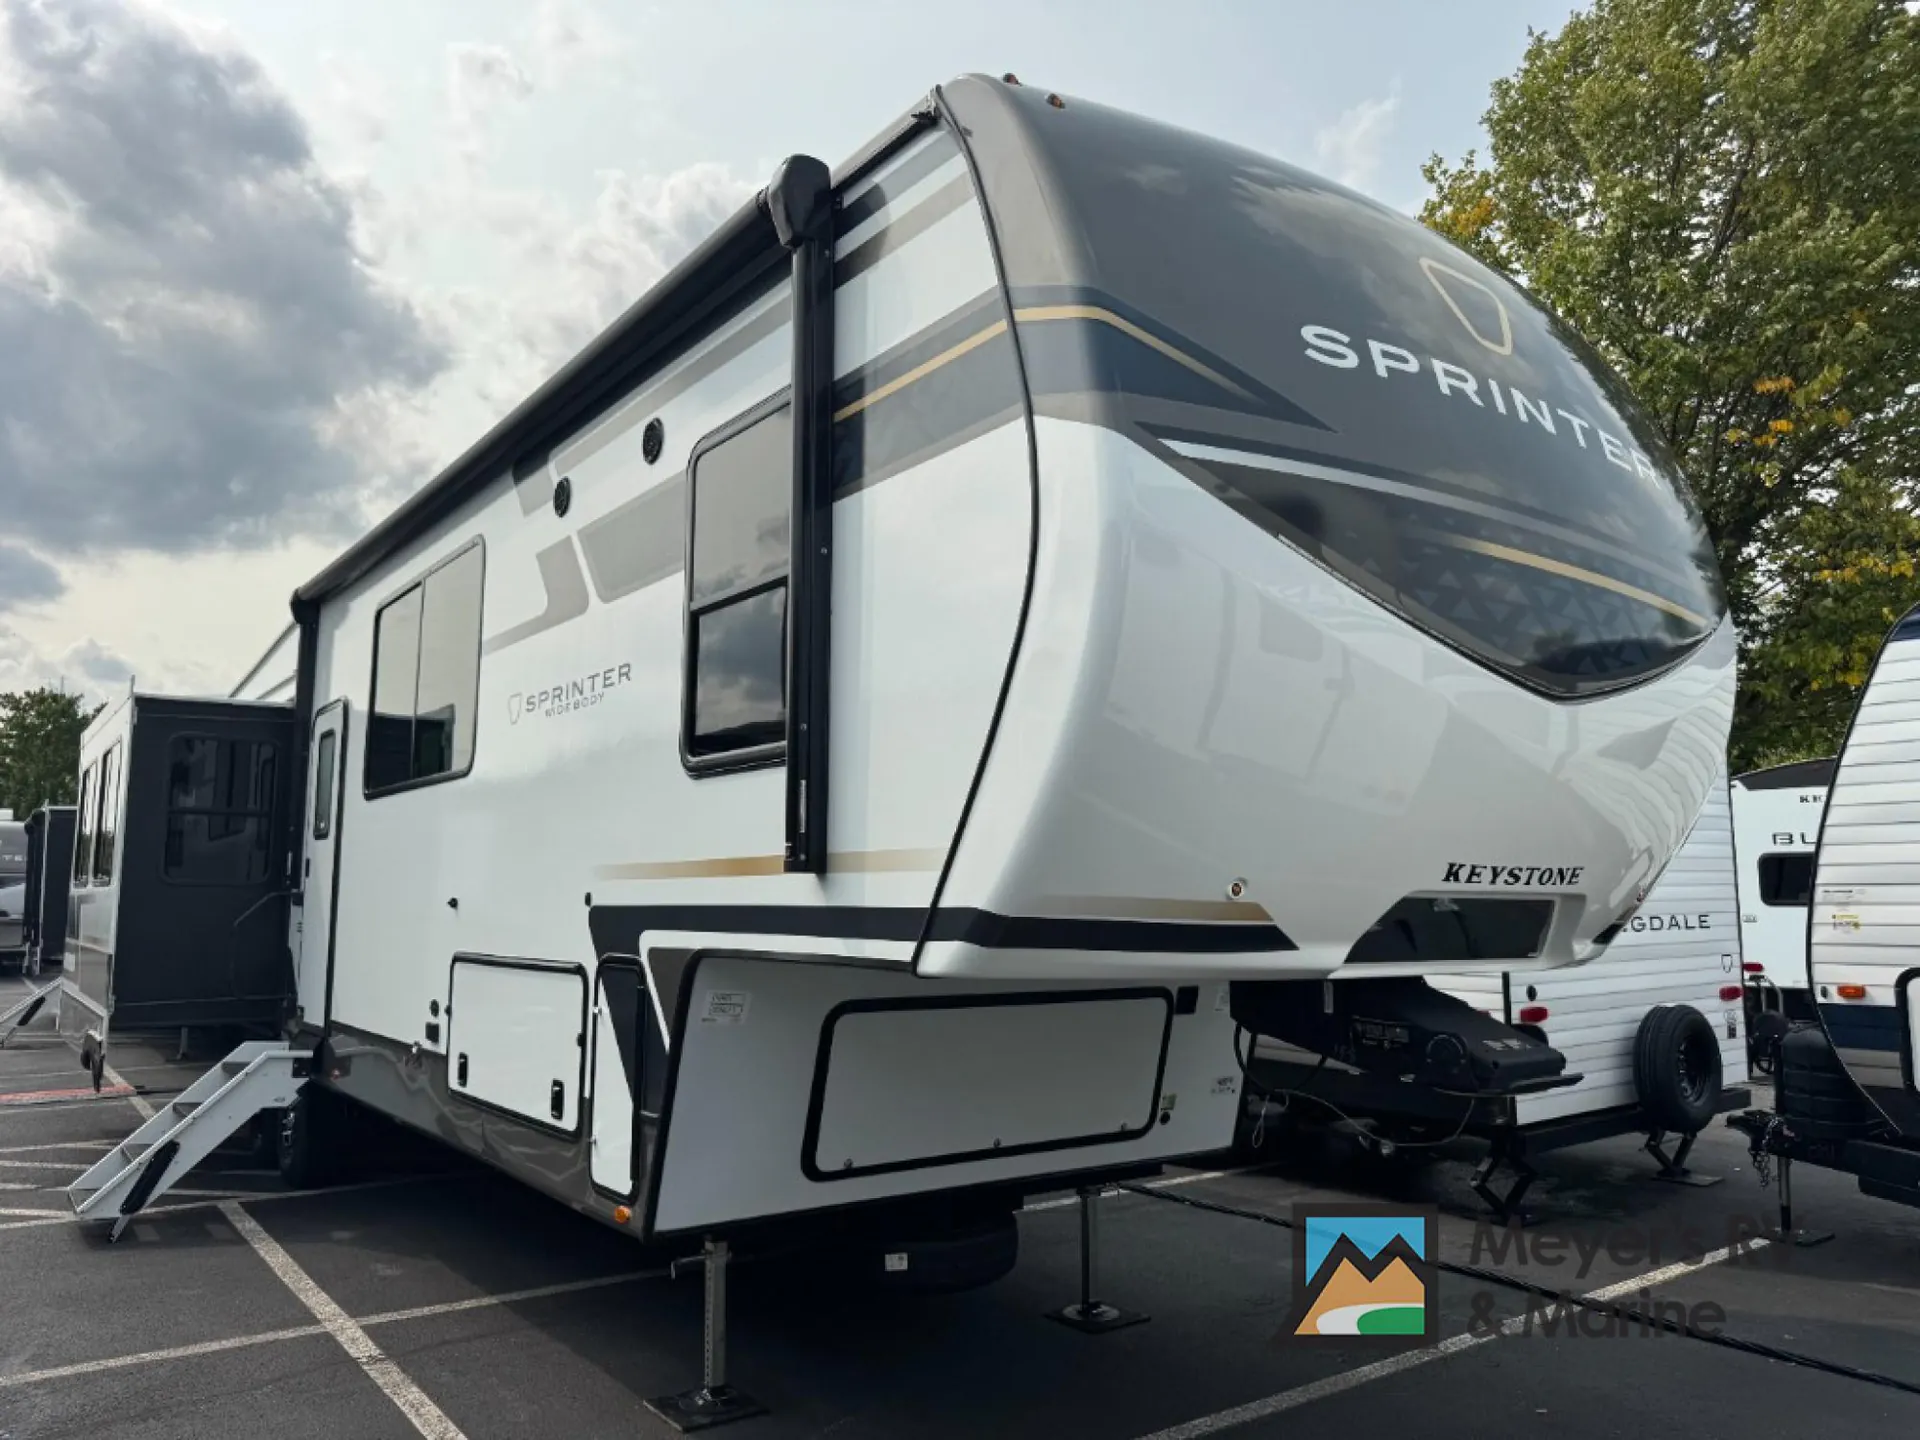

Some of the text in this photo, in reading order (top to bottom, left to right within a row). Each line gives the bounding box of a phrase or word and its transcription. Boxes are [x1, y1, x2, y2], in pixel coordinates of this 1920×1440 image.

[1301, 324, 1662, 490] SPRINTER
[525, 662, 632, 713] SPRINTER
[1442, 862, 1585, 886] KEYSTONE
[1623, 914, 1711, 932] GDALE
